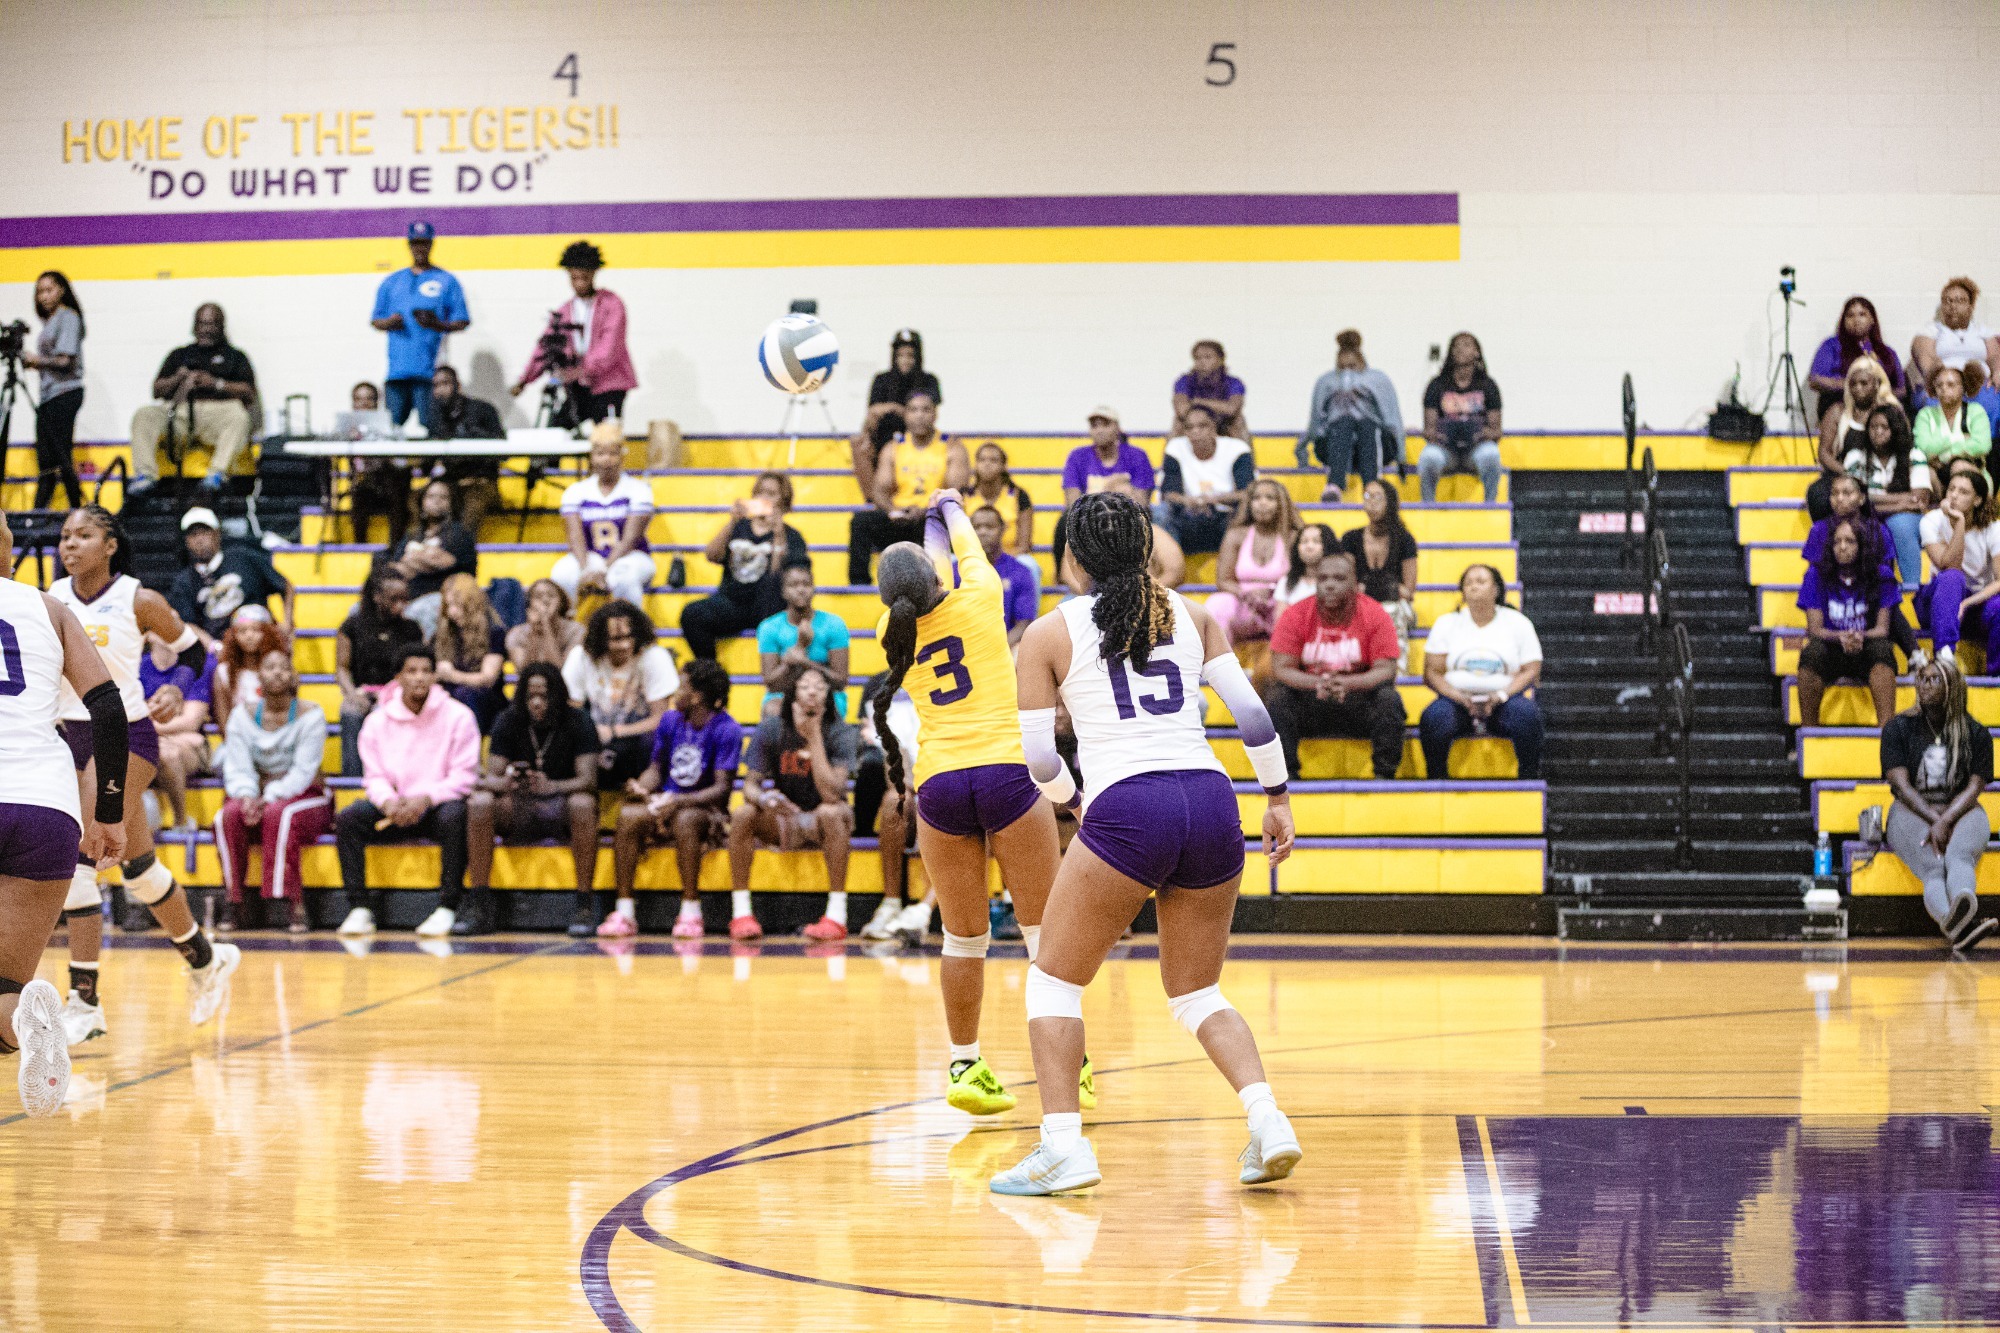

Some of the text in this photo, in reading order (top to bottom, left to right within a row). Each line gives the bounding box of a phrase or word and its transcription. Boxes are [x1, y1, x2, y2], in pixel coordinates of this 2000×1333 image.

[552, 52, 581, 97] 4
[1205, 43, 1237, 87] 5
[63, 104, 620, 164] HOME OF THE TIGERS!!
[230, 167, 349, 197] WHAT
[373, 166, 432, 193] WE
[915, 635, 974, 707] 3
[1099, 632, 1185, 720] 15
